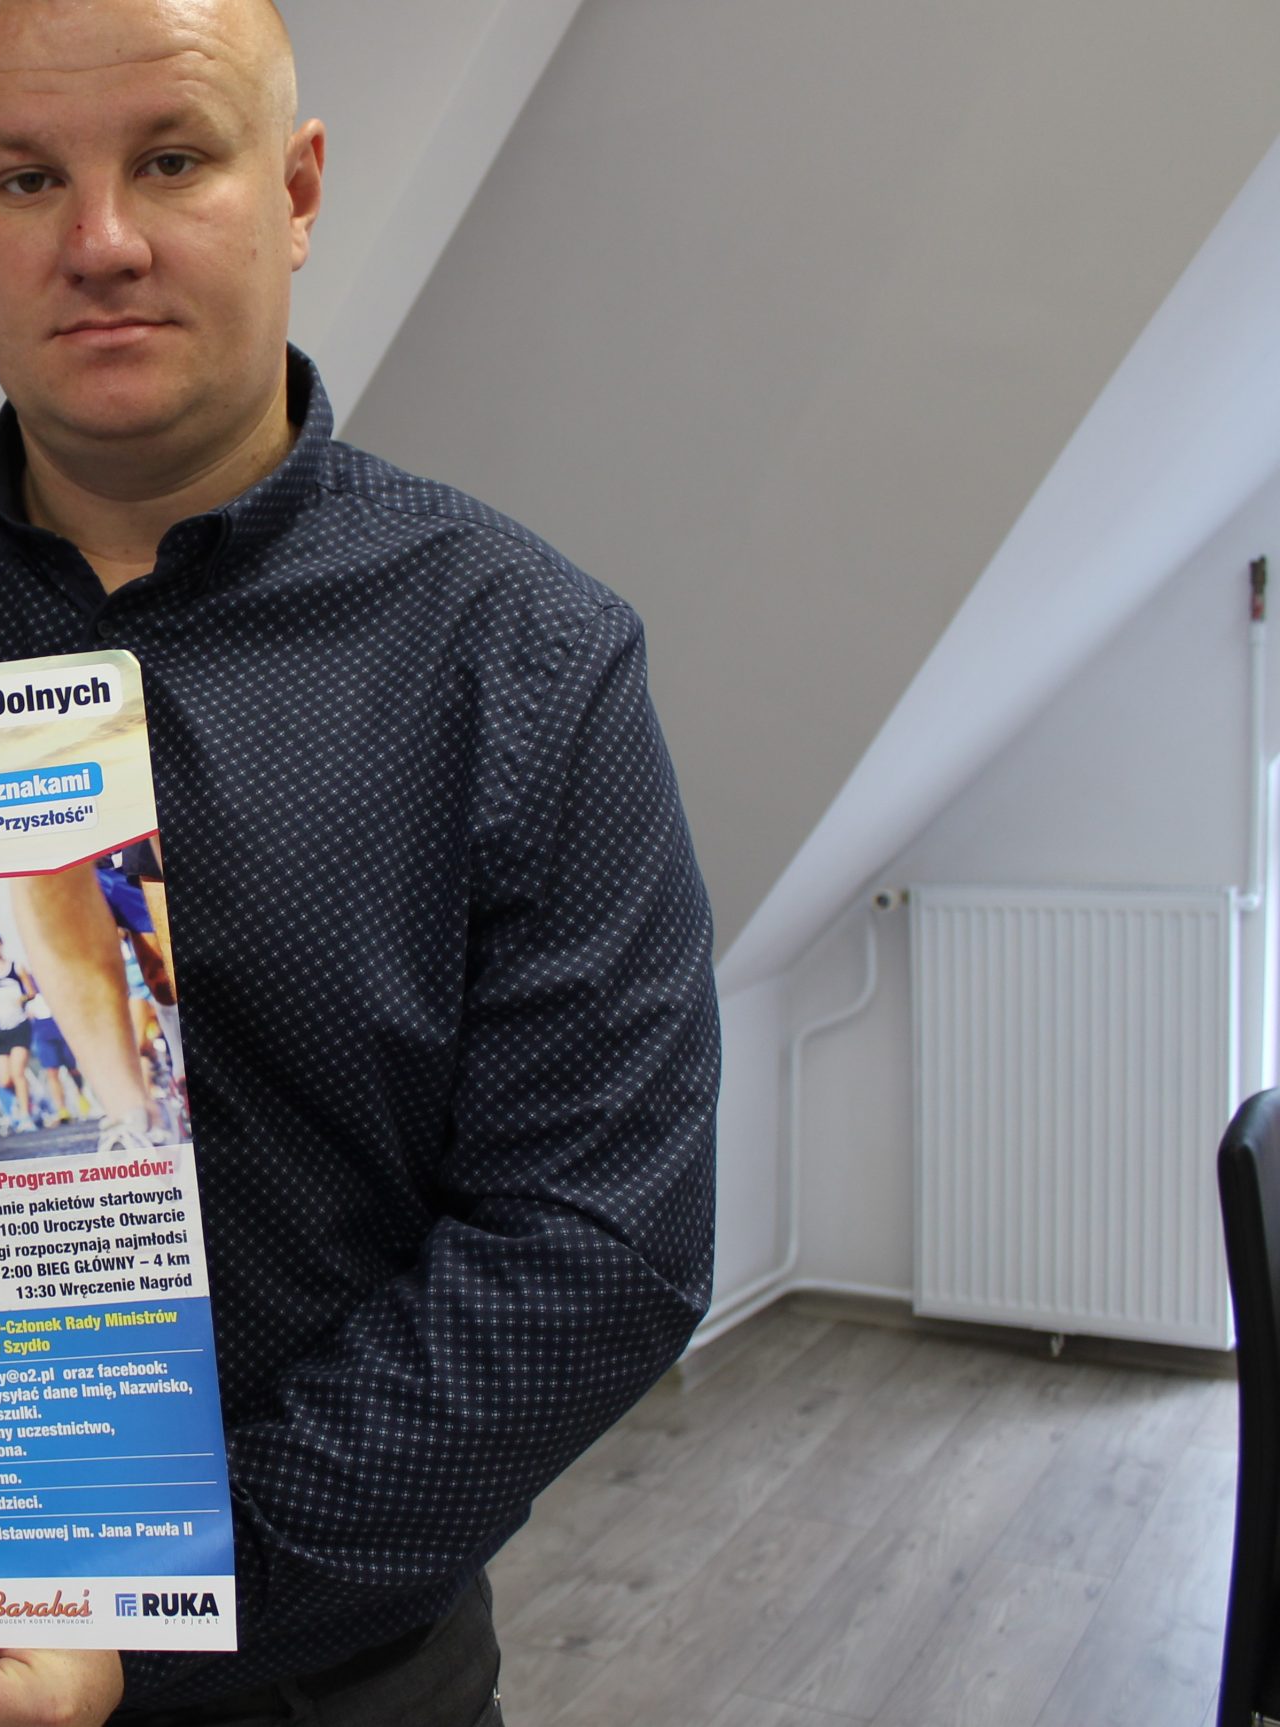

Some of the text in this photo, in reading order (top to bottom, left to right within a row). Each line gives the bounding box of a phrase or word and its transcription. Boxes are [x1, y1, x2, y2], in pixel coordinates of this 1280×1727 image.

[79, 1158, 174, 1182] zawodów:
[28, 1196, 94, 1216] pakietów
[99, 1186, 182, 1207] startowych
[0, 1208, 185, 1236] 10:00 Uroczyste Otwarcie
[14, 1236, 110, 1258] rozpoczynają
[115, 1229, 187, 1250] najmłodsi
[36, 1261, 70, 1276] BIEG
[74, 1255, 134, 1274] GŁÓWNY
[166, 1252, 190, 1266] km
[16, 1273, 192, 1299] 13:30 Wręczenie Nagród
[65, 1315, 101, 1331] Rady
[104, 1310, 177, 1327] Ministrów
[3, 1338, 50, 1356] Szydło
[62, 1367, 94, 1380] oraz
[97, 1360, 168, 1377] facebook:
[43, 1385, 78, 1400] dane
[81, 1383, 116, 1400] Imię,
[119, 1378, 193, 1395] Nazwisko,
[17, 1421, 115, 1438] uczestnictwo,
[72, 1524, 94, 1538] im.
[98, 1523, 132, 1538] Jana
[135, 1522, 180, 1536] Pawła
[142, 1592, 220, 1617] RUKA
[164, 1617, 219, 1625] projekt
